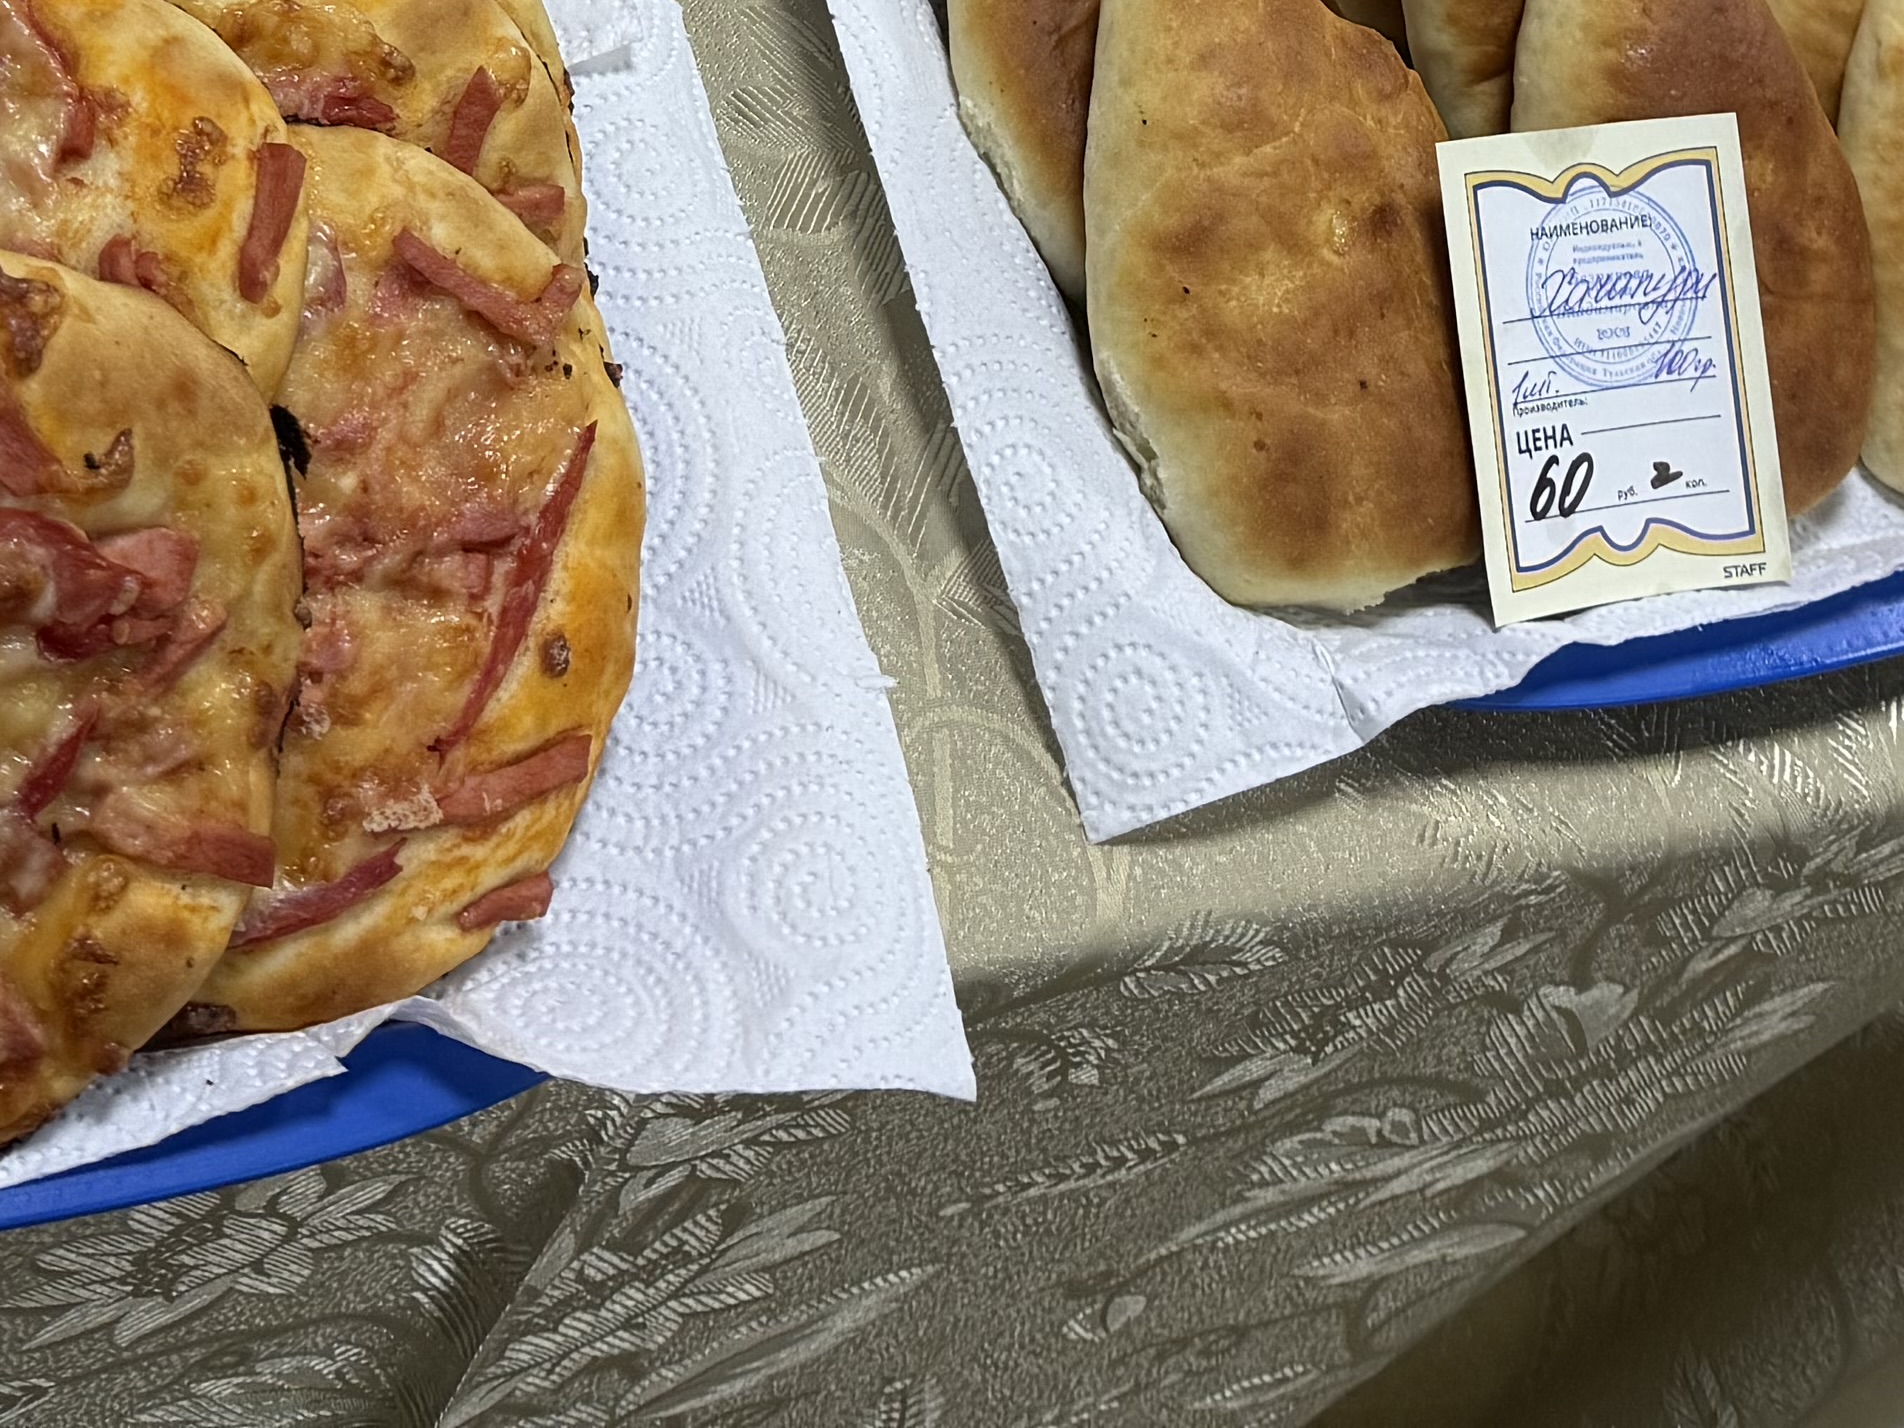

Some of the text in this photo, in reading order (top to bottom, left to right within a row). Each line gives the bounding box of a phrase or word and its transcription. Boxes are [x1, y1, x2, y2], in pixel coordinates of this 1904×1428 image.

[1512, 397, 1588, 418] Производитель:
[1516, 423, 1574, 459] ЦЕНА
[1529, 451, 1595, 521] 60
[1617, 485, 1638, 501] руб.
[1685, 479, 1708, 490] коп.
[1723, 561, 1767, 580] STAFF
